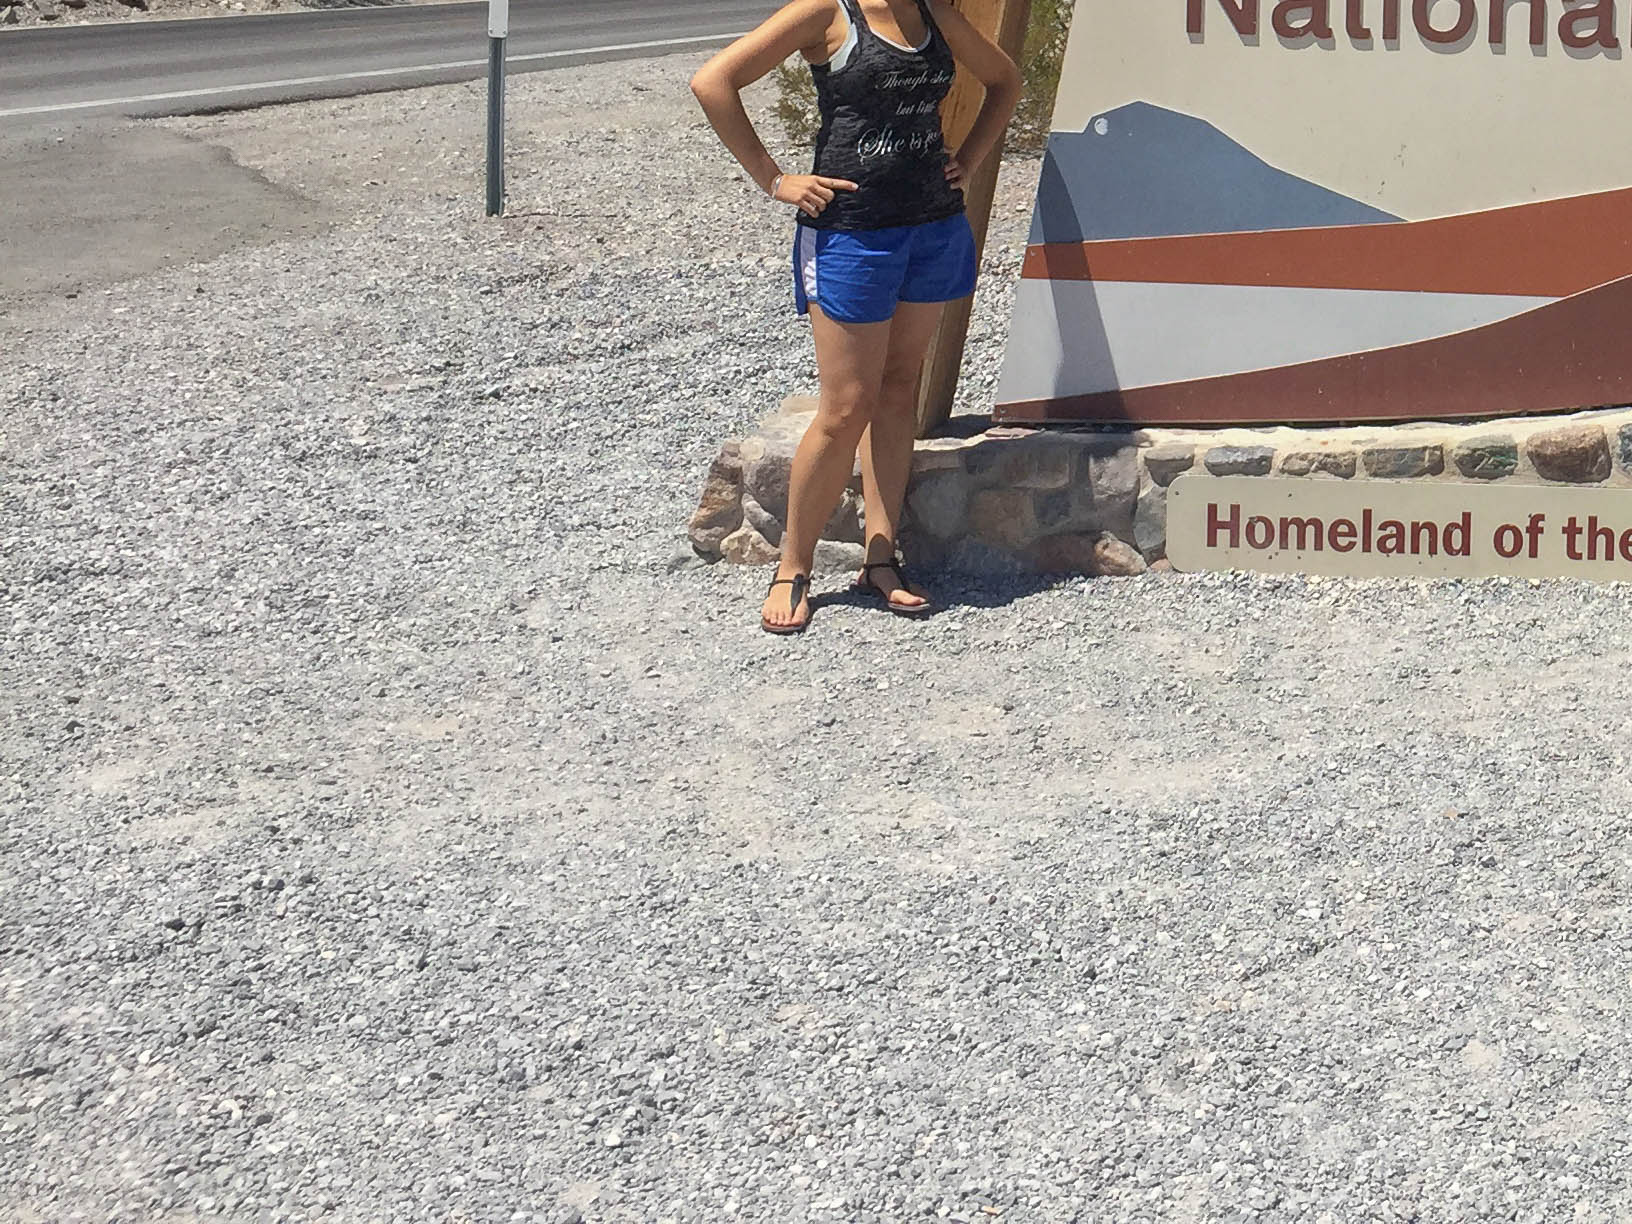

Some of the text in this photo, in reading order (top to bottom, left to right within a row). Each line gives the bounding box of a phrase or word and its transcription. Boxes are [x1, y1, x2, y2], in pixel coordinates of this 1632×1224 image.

[857, 123, 905, 166] She
[1206, 502, 1473, 557] Homeland
[1493, 512, 1547, 559] of
